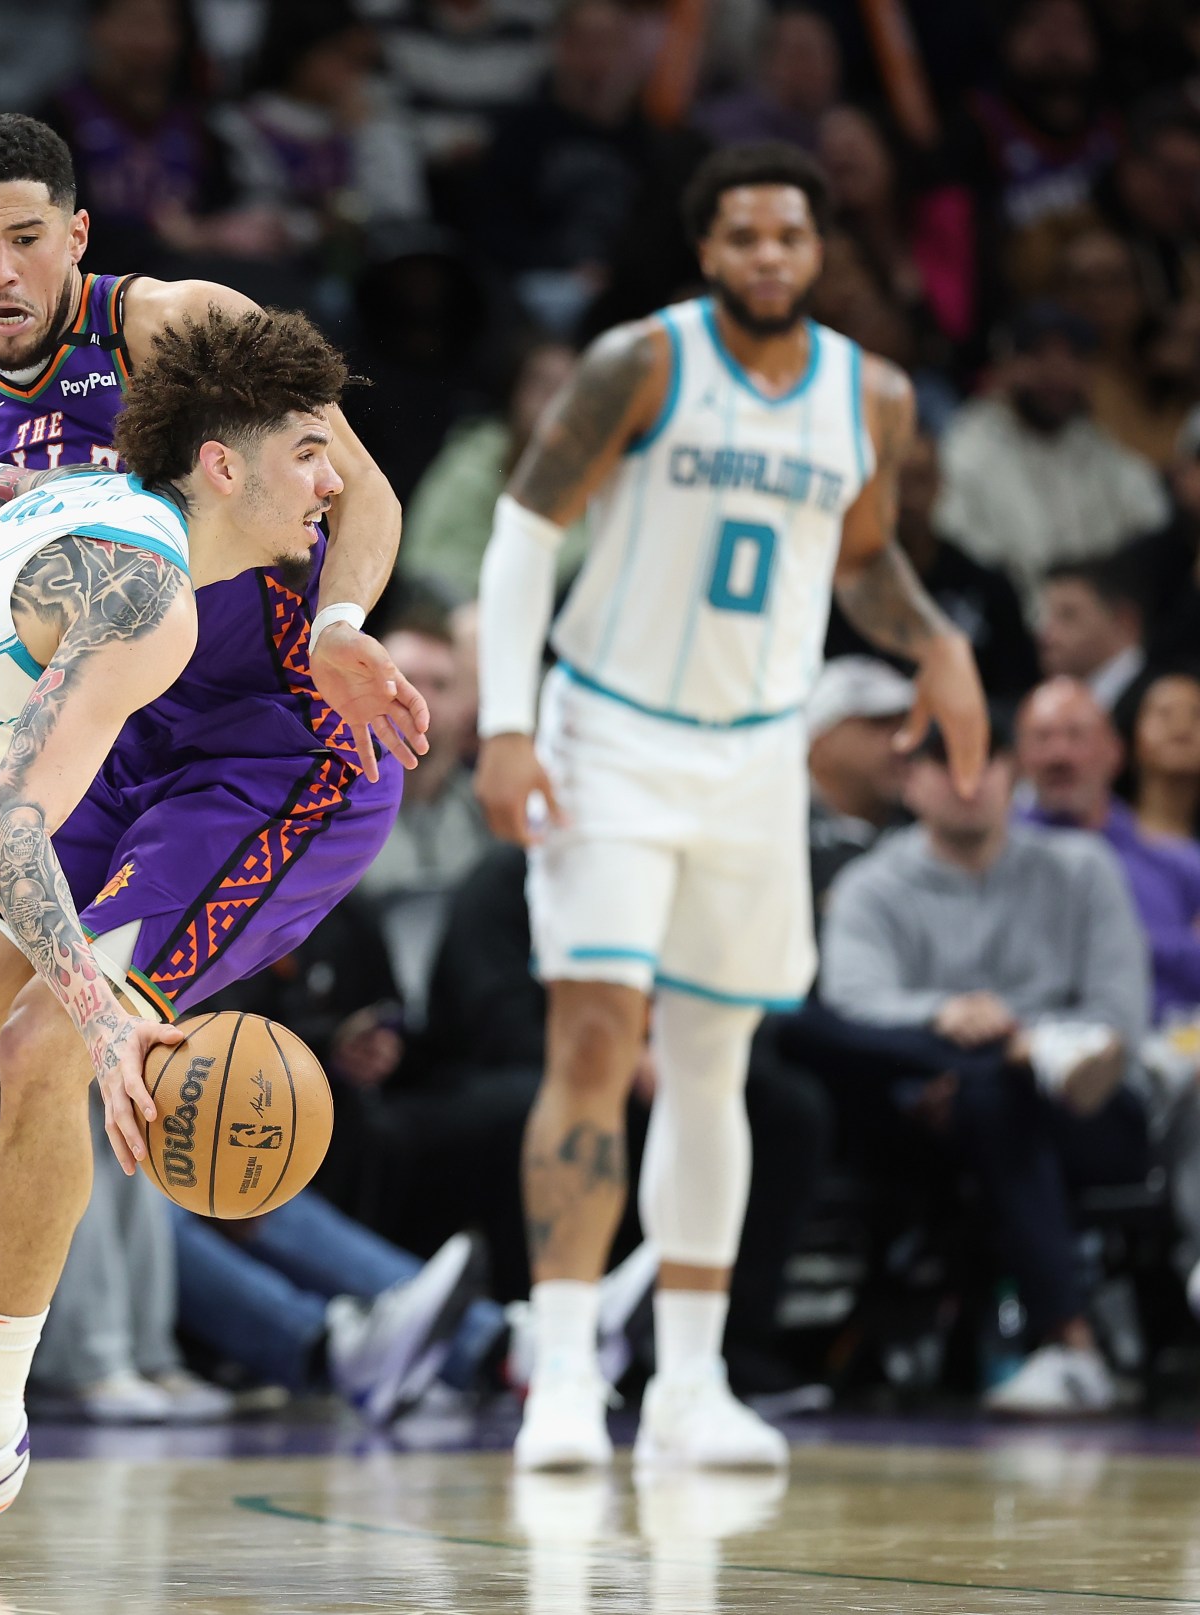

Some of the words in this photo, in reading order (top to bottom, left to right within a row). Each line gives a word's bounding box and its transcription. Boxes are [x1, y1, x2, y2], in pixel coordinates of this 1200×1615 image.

[60, 371, 117, 397] PayPal
[14, 411, 63, 449] THE
[708, 520, 776, 614] 0
[162, 1055, 217, 1189] Wilson
